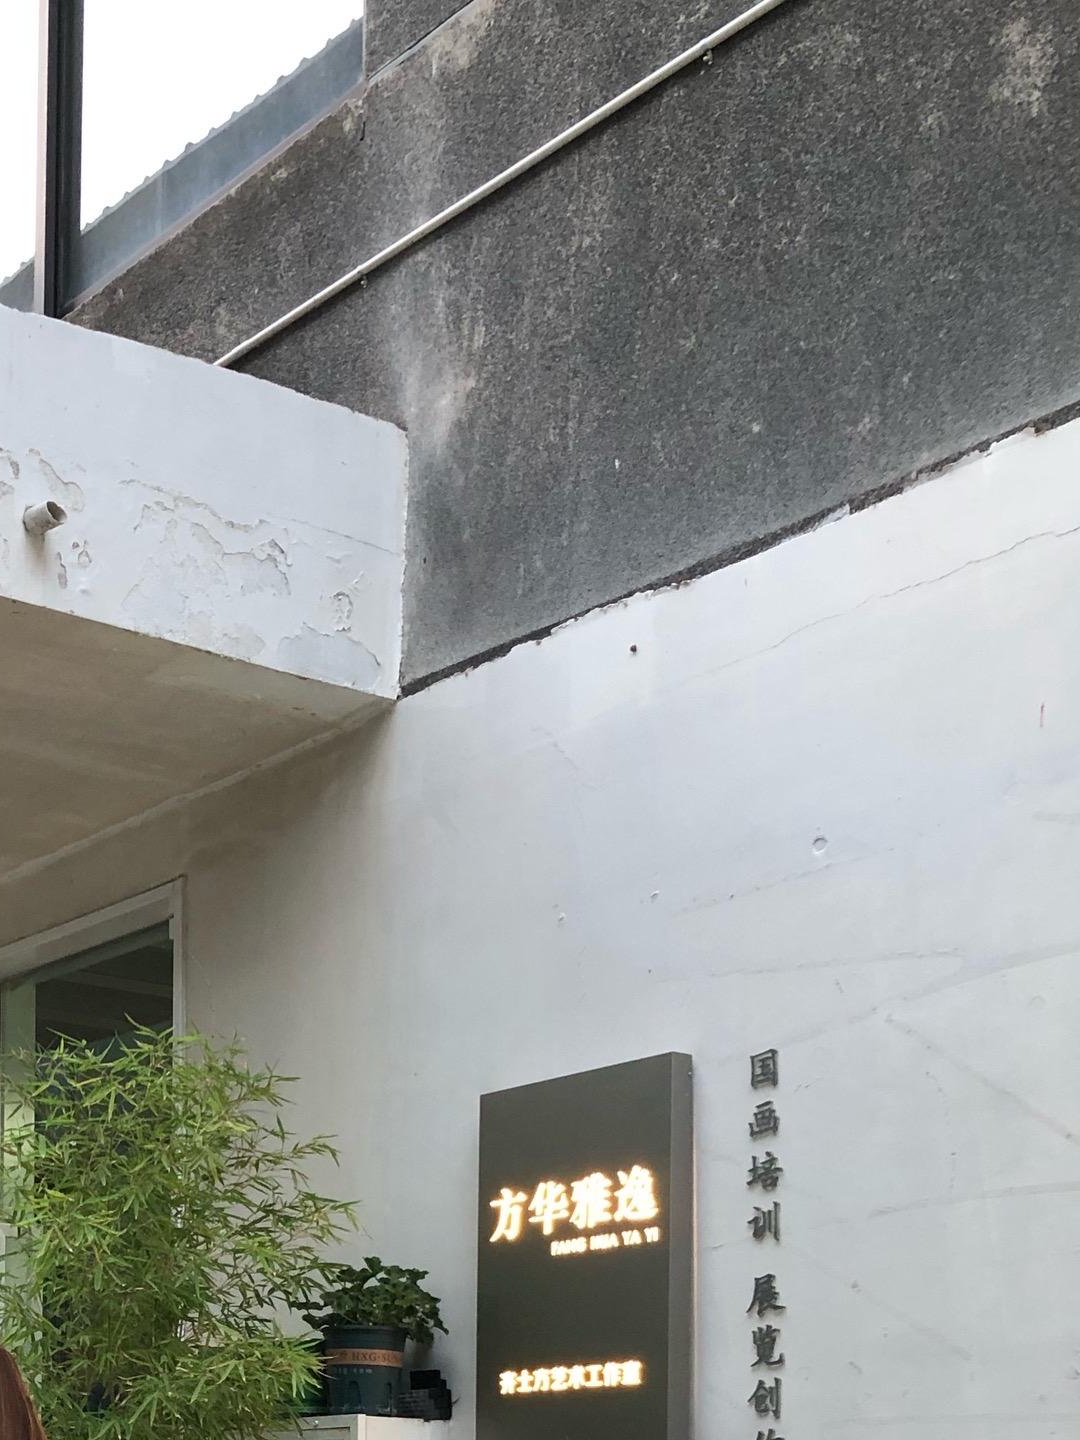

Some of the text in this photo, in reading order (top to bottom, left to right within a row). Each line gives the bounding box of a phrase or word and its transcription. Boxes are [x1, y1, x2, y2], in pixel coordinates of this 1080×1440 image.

[747, 1048, 784, 1243] 国画培训
[489, 1164, 660, 1244] 方华雅逸
[550, 1226, 661, 1256] FANG HUA YA YI
